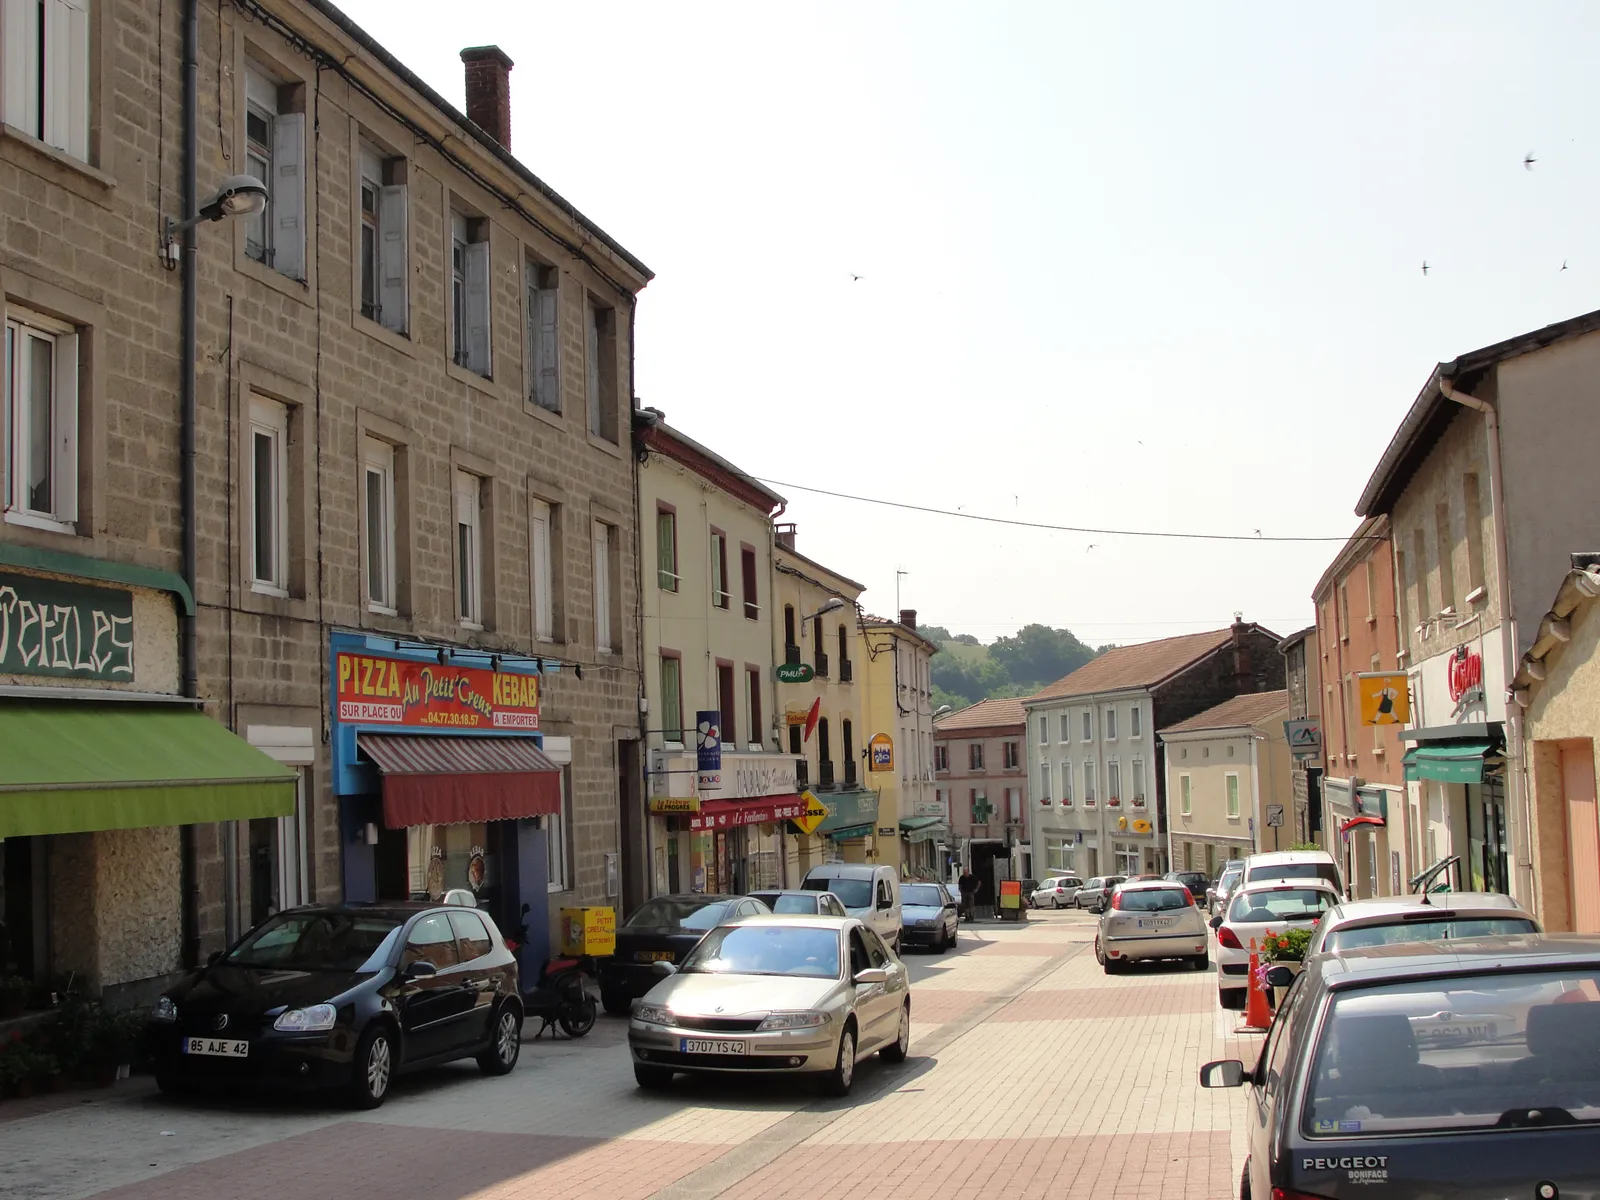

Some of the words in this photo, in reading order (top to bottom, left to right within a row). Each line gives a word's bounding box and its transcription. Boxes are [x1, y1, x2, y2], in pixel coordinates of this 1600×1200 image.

[339, 655, 401, 698] PIZZA
[780, 670, 798, 678] PMU
[402, 677, 420, 713] Au
[493, 674, 537, 708] KEBAB
[342, 704, 359, 717] SUR
[362, 705, 388, 718] PLACE
[391, 707, 402, 719] OU
[428, 712, 479, 725] 04.77.30.18.57
[495, 713, 500, 724] A
[502, 714, 537, 726] EMPORTER
[597, 917, 612, 925] PETIT
[190, 1040, 203, 1051] 85
[208, 1041, 228, 1053] AJE
[233, 1042, 247, 1054] 42
[688, 1040, 714, 1052] 3707
[716, 1041, 729, 1053] YS
[731, 1042, 744, 1053] 42
[1302, 1156, 1388, 1170] PEUGEOT
[1348, 1170, 1388, 1179] BONIFACE
